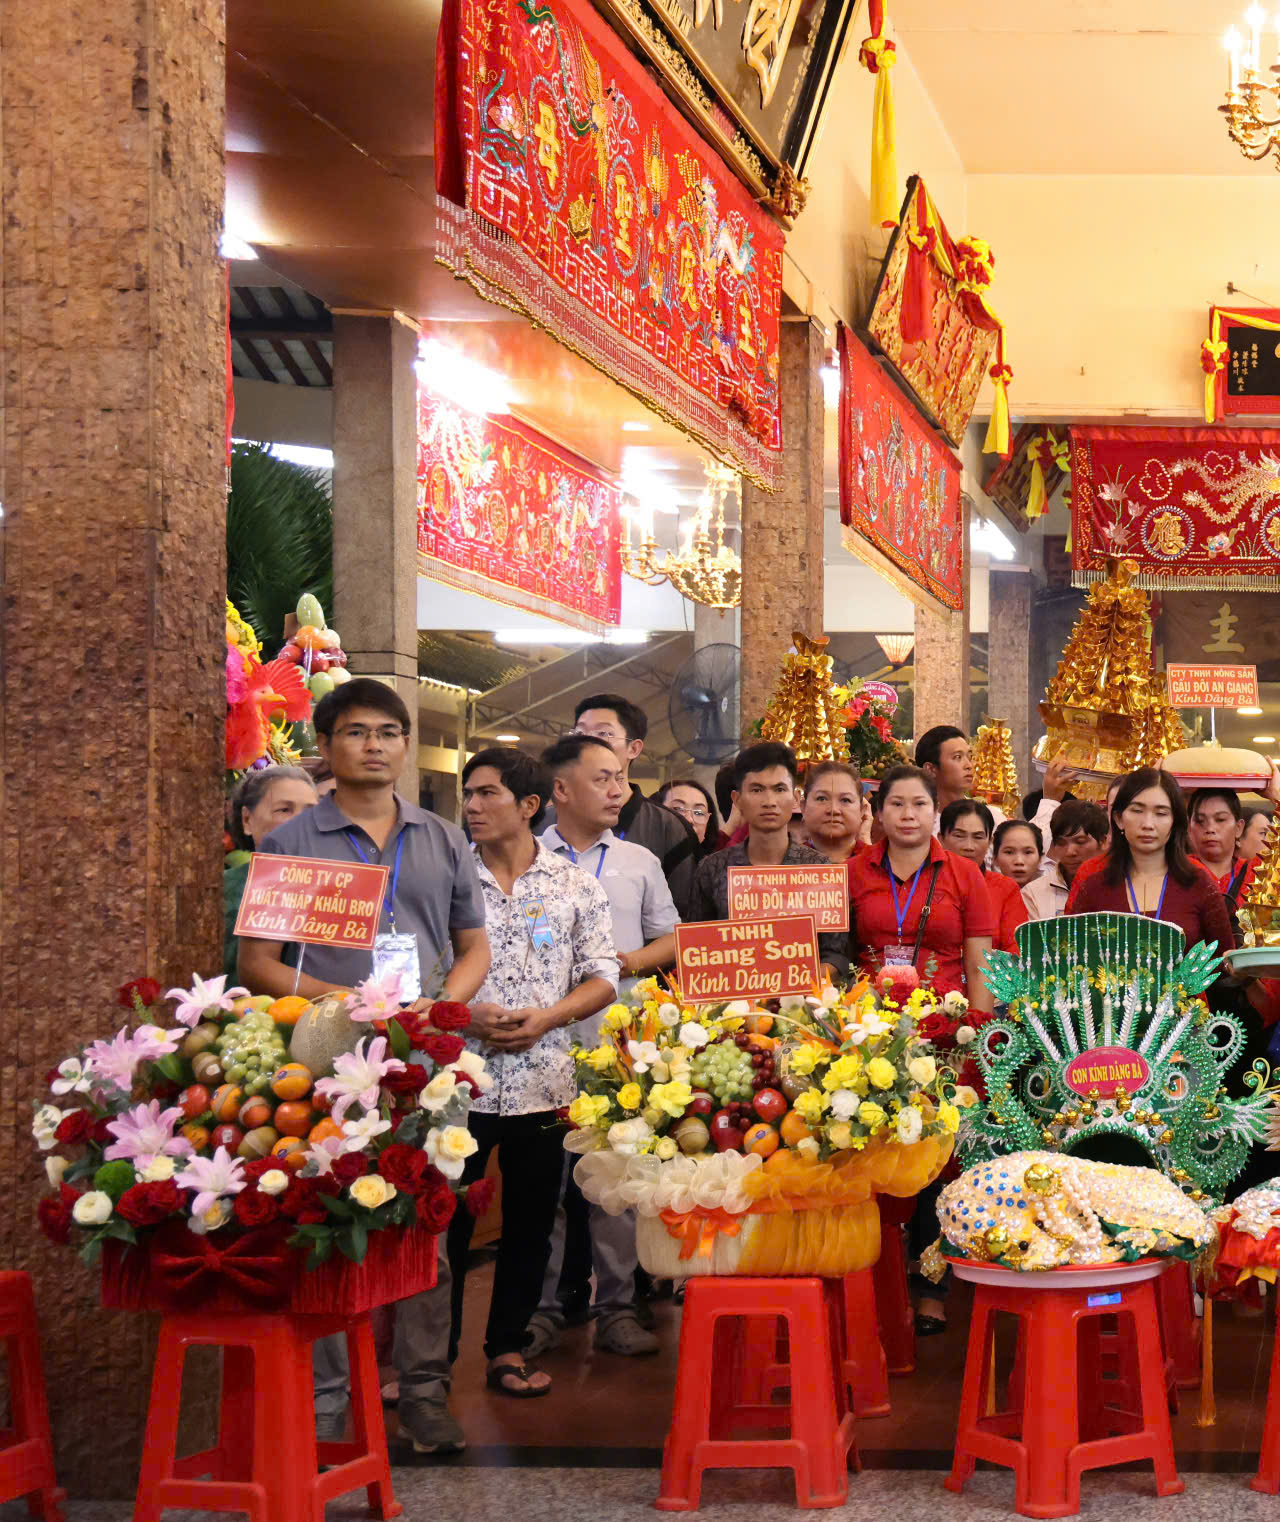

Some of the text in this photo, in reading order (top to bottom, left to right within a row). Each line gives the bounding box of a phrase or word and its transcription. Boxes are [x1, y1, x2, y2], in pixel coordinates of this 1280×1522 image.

[1171, 670, 1186, 678] CTY
[1189, 670, 1211, 678] TNHH
[1214, 668, 1235, 678] NÔNG
[1172, 677, 1191, 693] GẤU
[1212, 682, 1224, 692] AN
[1226, 682, 1254, 694] GIANG
[1175, 693, 1253, 706] Kính Dâng Bà
[279, 863, 354, 888] CÔNG TY CP
[733, 869, 843, 887] CTY TNHH NÔNG SẢN
[249, 885, 374, 917] XUẤT NHẬP KHẨU BRO
[734, 887, 843, 911] GẤU ĐÔI AN GIANG
[245, 910, 369, 940] Kính Dâng Bà
[821, 910, 841, 925] Bà
[717, 923, 773, 942] TNHH
[682, 940, 813, 968] Giang Sơn
[688, 963, 812, 995] Kính Dâng Bà
[1072, 1067, 1088, 1085] CON
[1088, 1062, 1109, 1082] KÍNH
